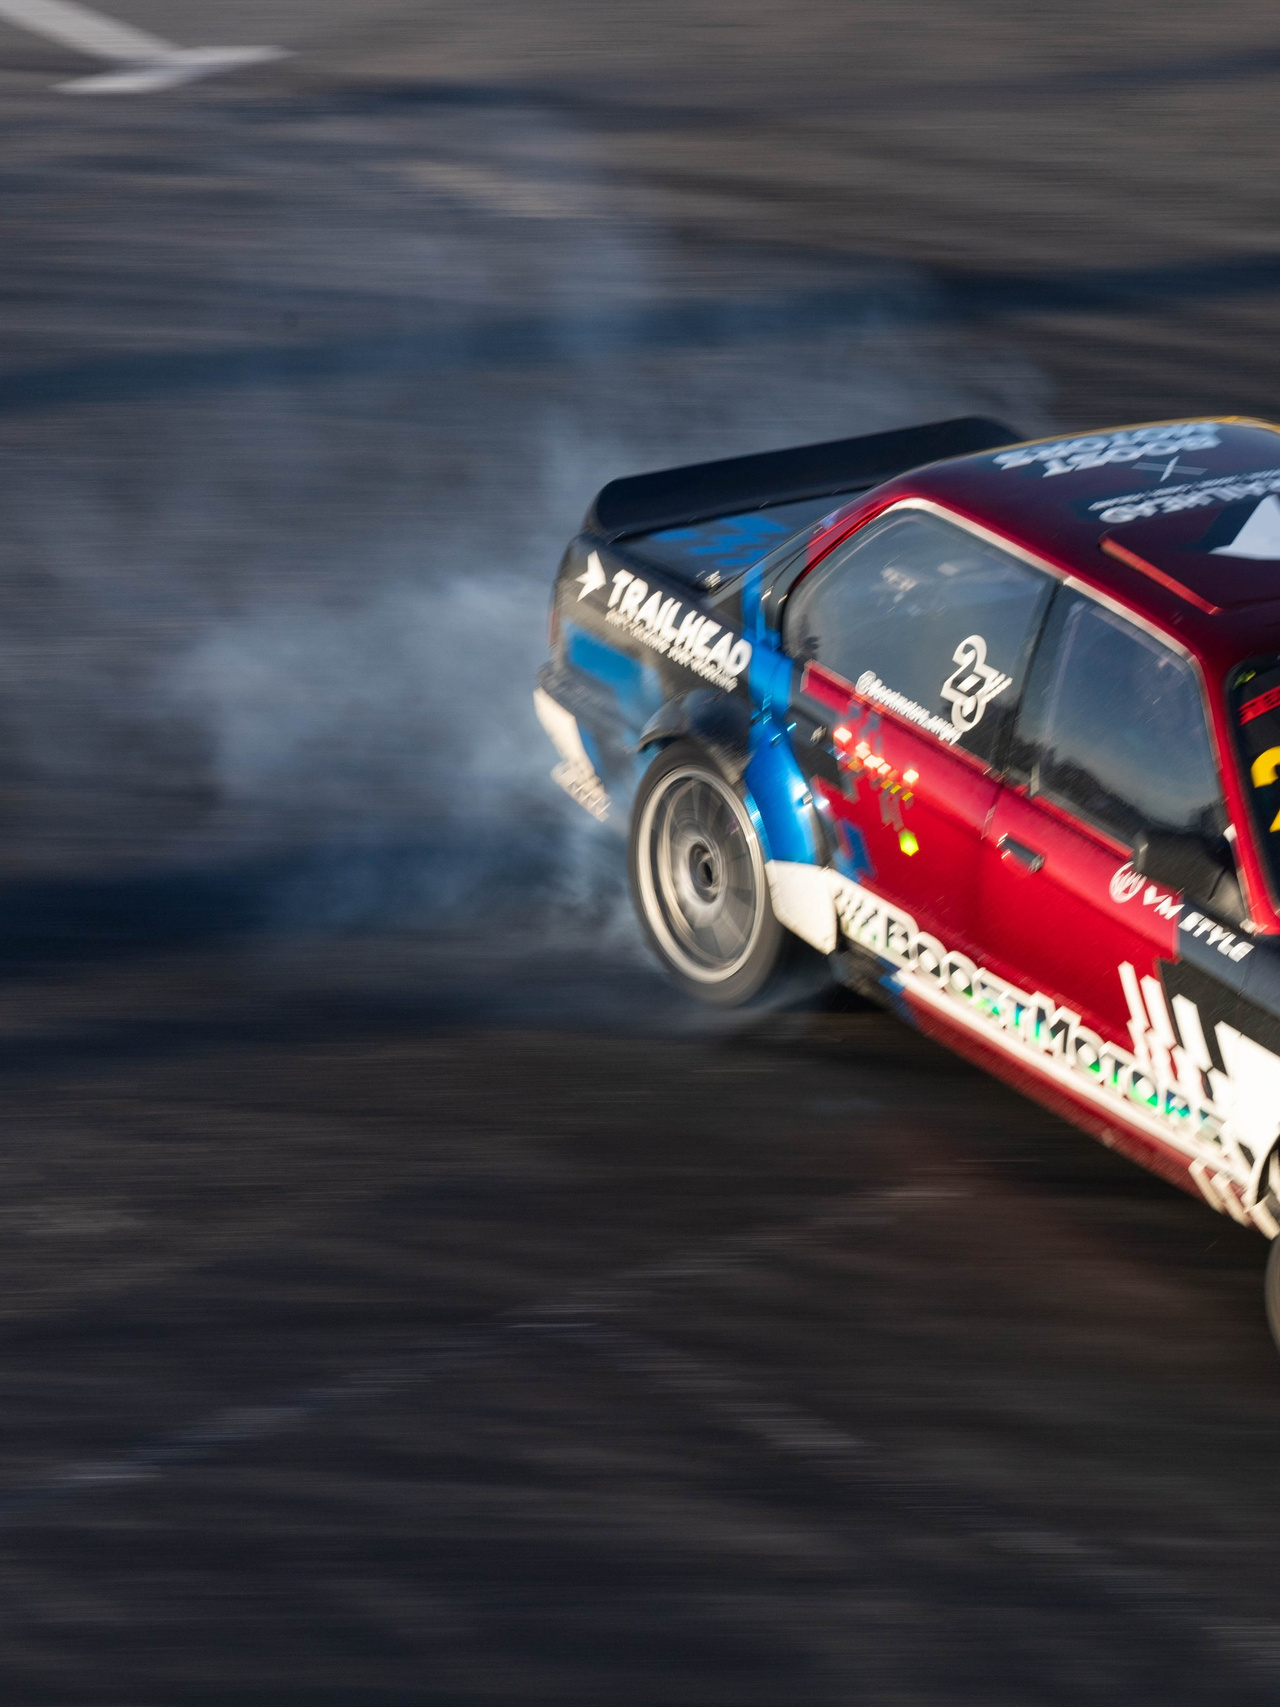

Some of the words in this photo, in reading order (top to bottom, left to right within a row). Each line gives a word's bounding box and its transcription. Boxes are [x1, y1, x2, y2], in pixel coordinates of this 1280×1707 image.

[607, 568, 752, 677] TRAILHEAD
[1143, 884, 1185, 920] VM
[1178, 911, 1254, 962] STYLE
